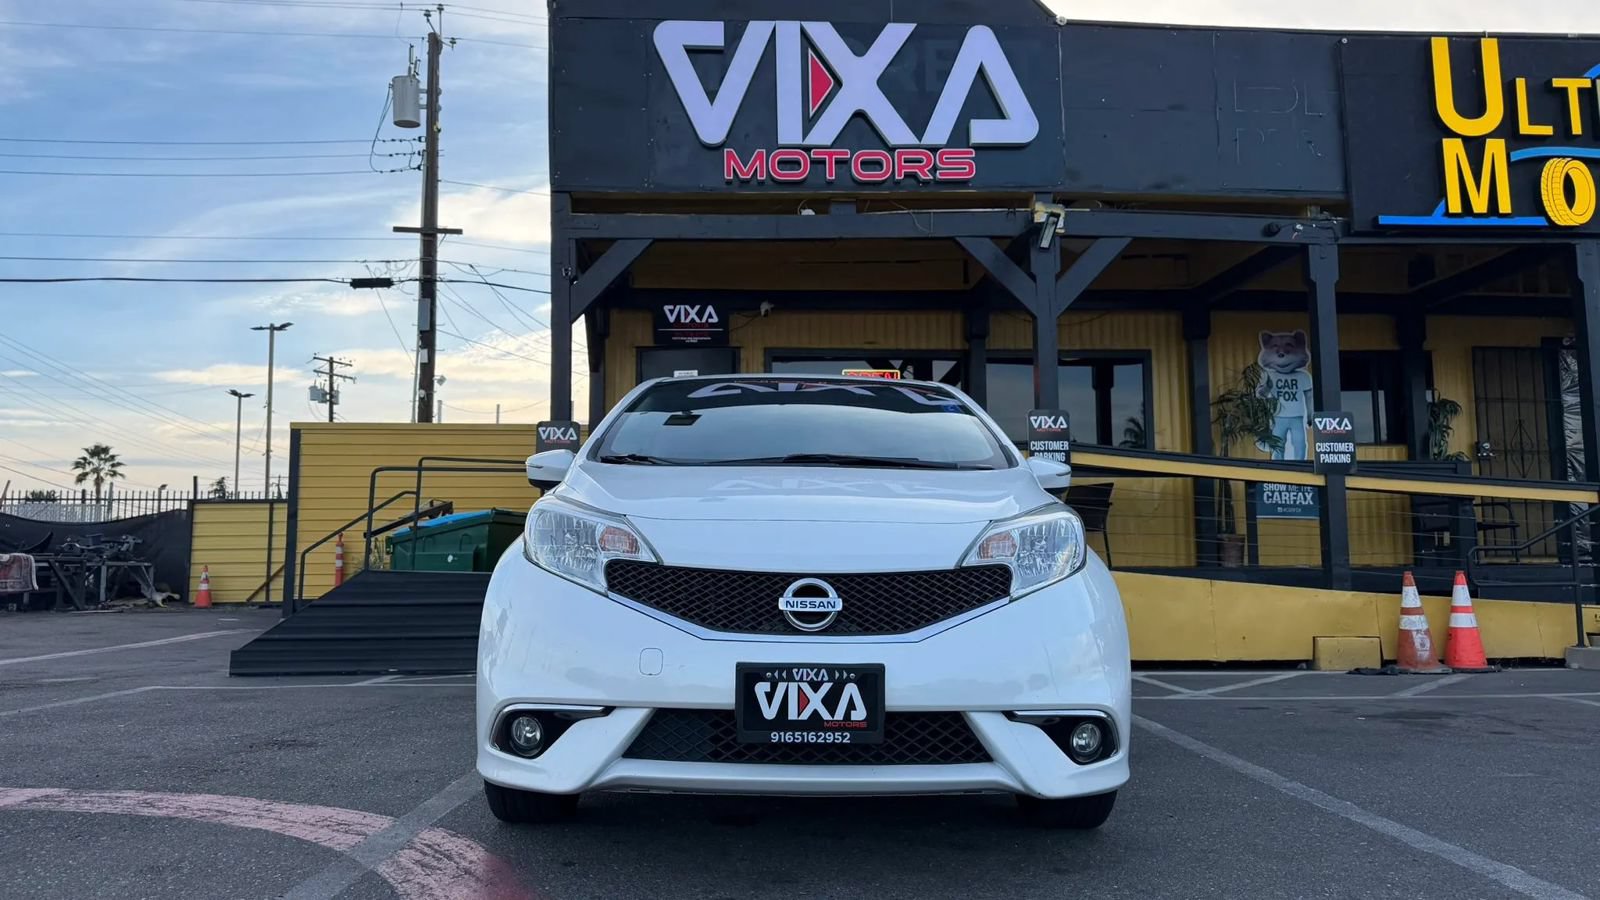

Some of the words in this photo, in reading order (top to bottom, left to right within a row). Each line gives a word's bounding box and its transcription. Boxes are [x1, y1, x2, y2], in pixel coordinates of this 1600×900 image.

[653, 20, 1039, 147] VIXA
[1430, 36, 1600, 136] ULT
[723, 148, 977, 182] MOTORS
[663, 304, 719, 323] VIXA
[1276, 379, 1298, 389] CAR
[1277, 391, 1298, 401] FOX
[1030, 416, 1067, 428] VIXA
[1314, 417, 1352, 430] VIXA
[538, 427, 577, 440] VIXA
[1030, 441, 1068, 450] CUSTOMER
[1315, 442, 1354, 453] CUSTOMER
[1320, 453, 1351, 464] PARKING
[1263, 483, 1287, 491] SHOW
[1263, 491, 1314, 505] CARFAX
[785, 600, 836, 609] NISSAN
[792, 668, 828, 681] VIXA
[754, 681, 867, 720] VIXA
[770, 732, 850, 743] 9165162952
